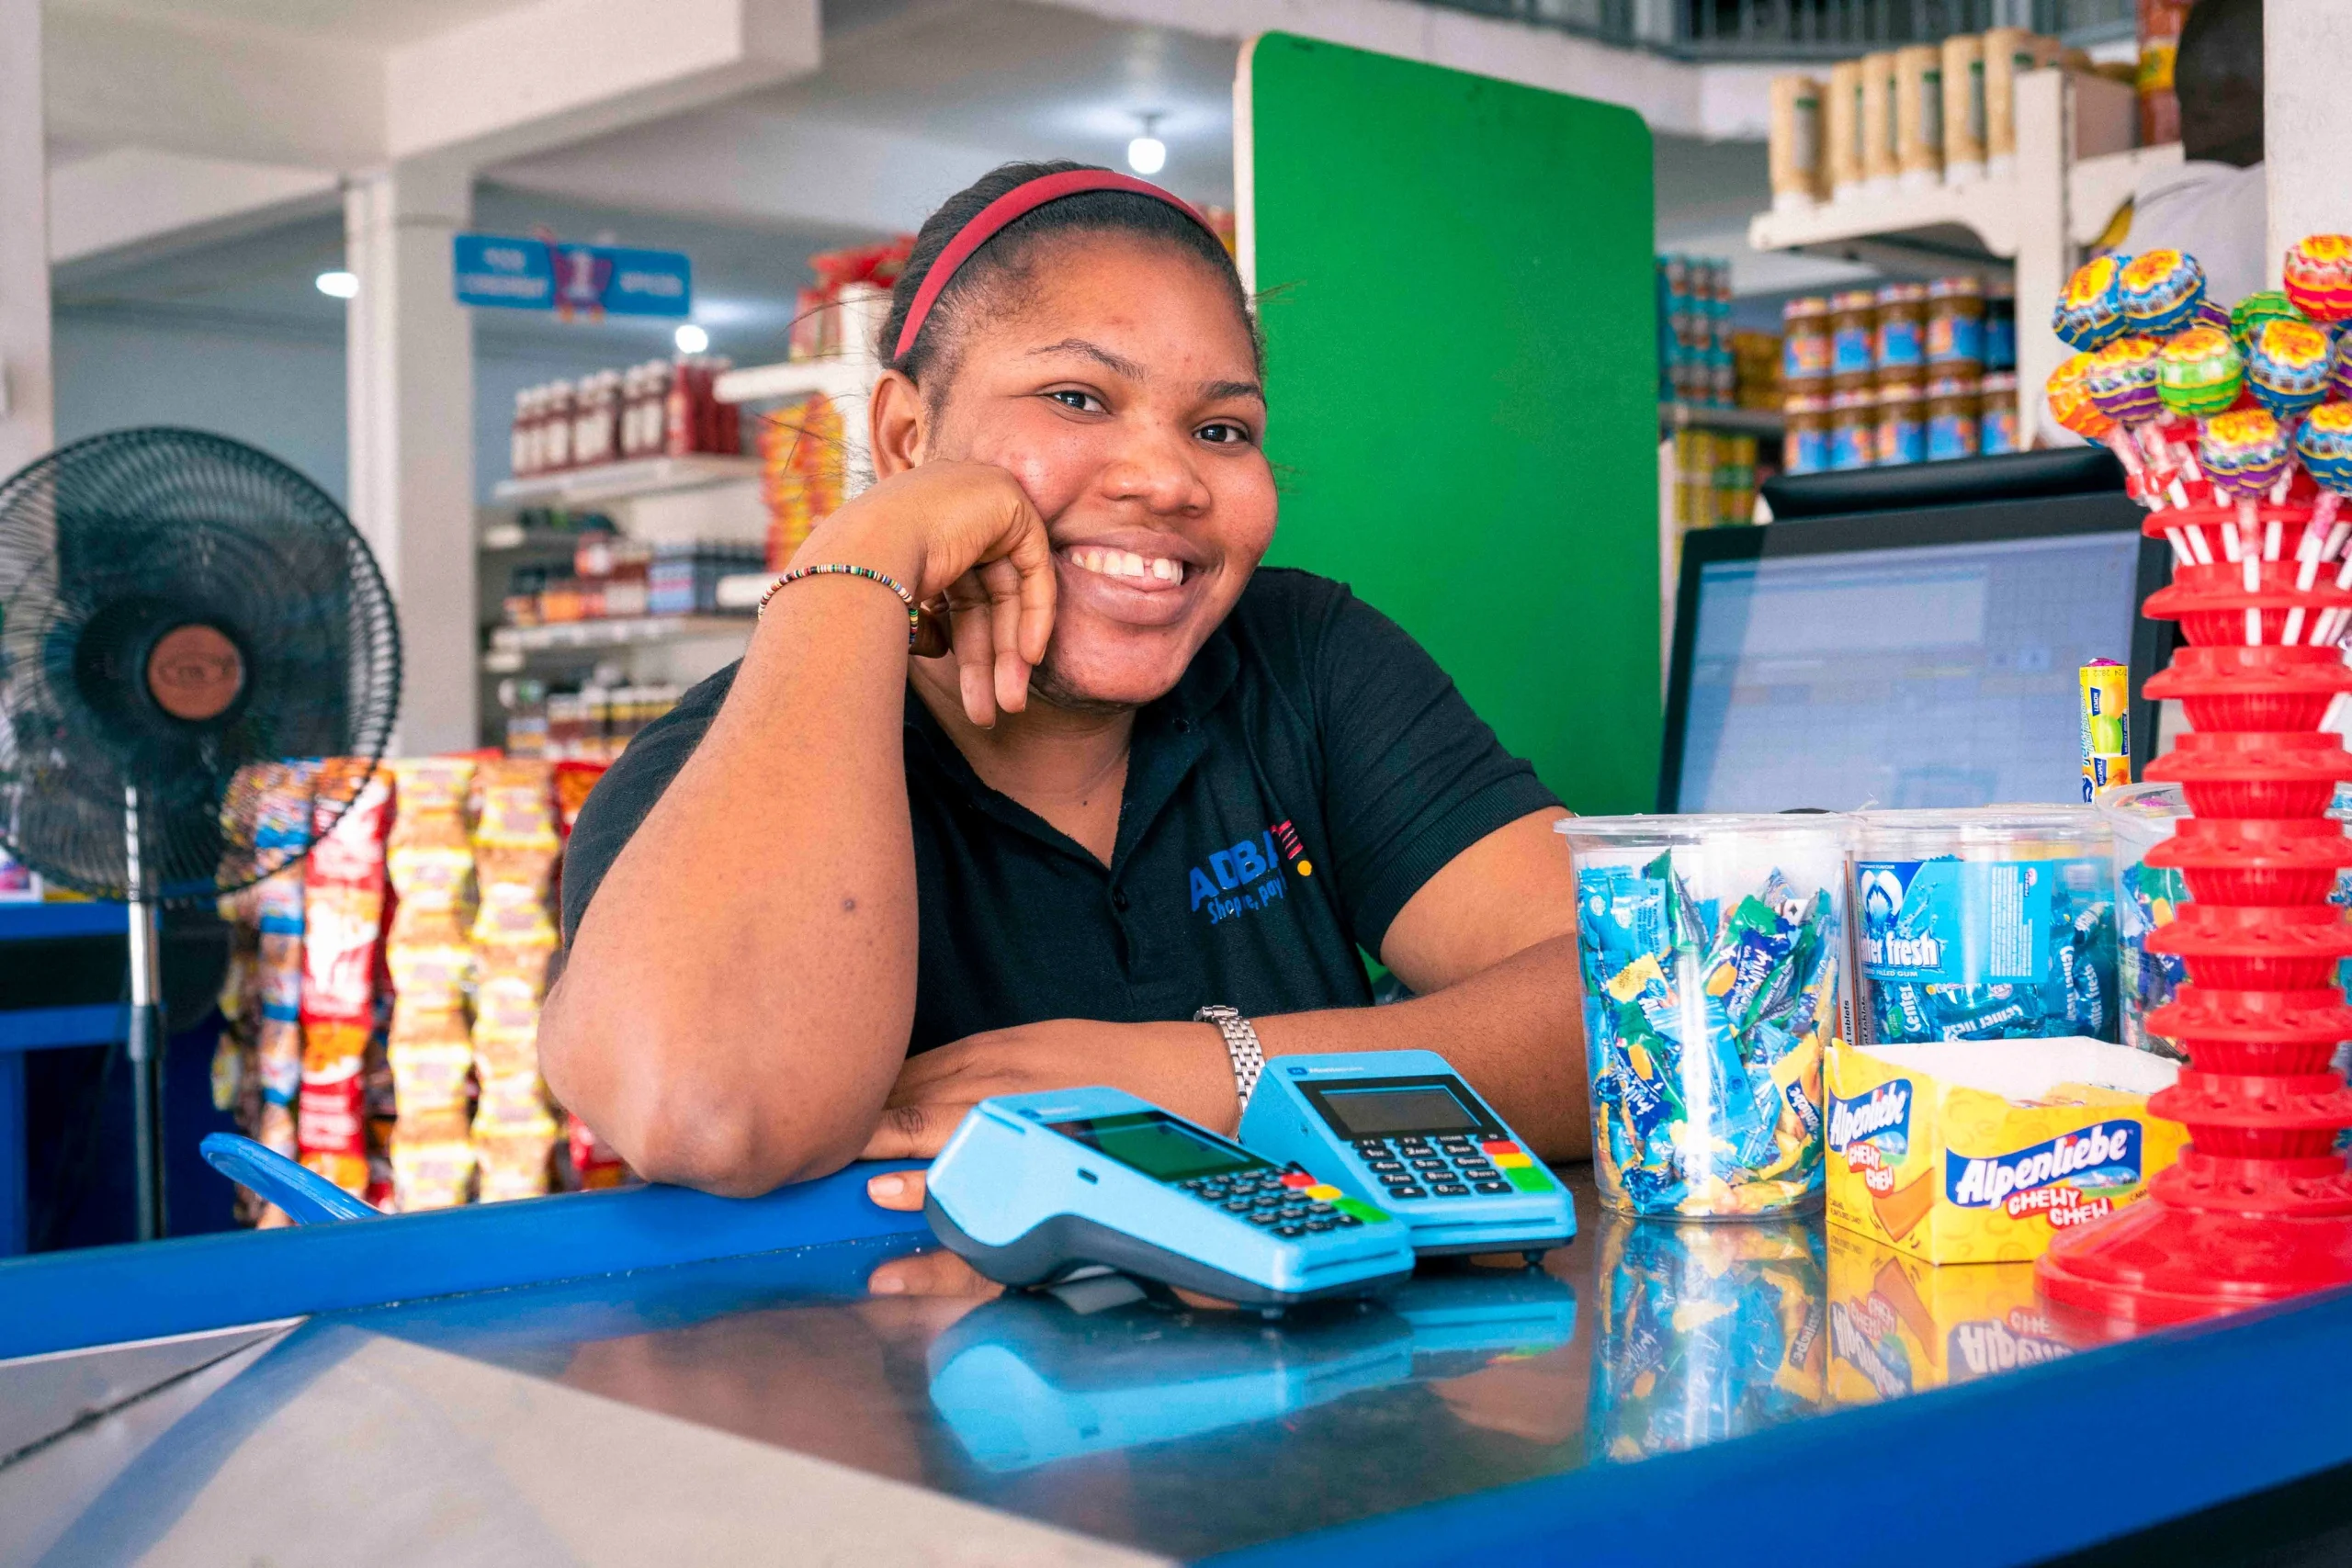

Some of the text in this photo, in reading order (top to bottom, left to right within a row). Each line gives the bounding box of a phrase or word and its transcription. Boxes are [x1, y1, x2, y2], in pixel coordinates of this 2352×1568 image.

[1885, 929, 1939, 967] fresh
[1898, 985, 1922, 1032] Center
[1830, 1081, 1906, 1157] Alpenliebe
[1849, 1144, 1881, 1171] CHEWY
[1955, 1124, 2128, 1211] Alpenliebe
[1866, 1165, 1894, 1192] CHEW
[2008, 1189, 2080, 1215] CHEWY
[2050, 1198, 2109, 1225] CHEW
